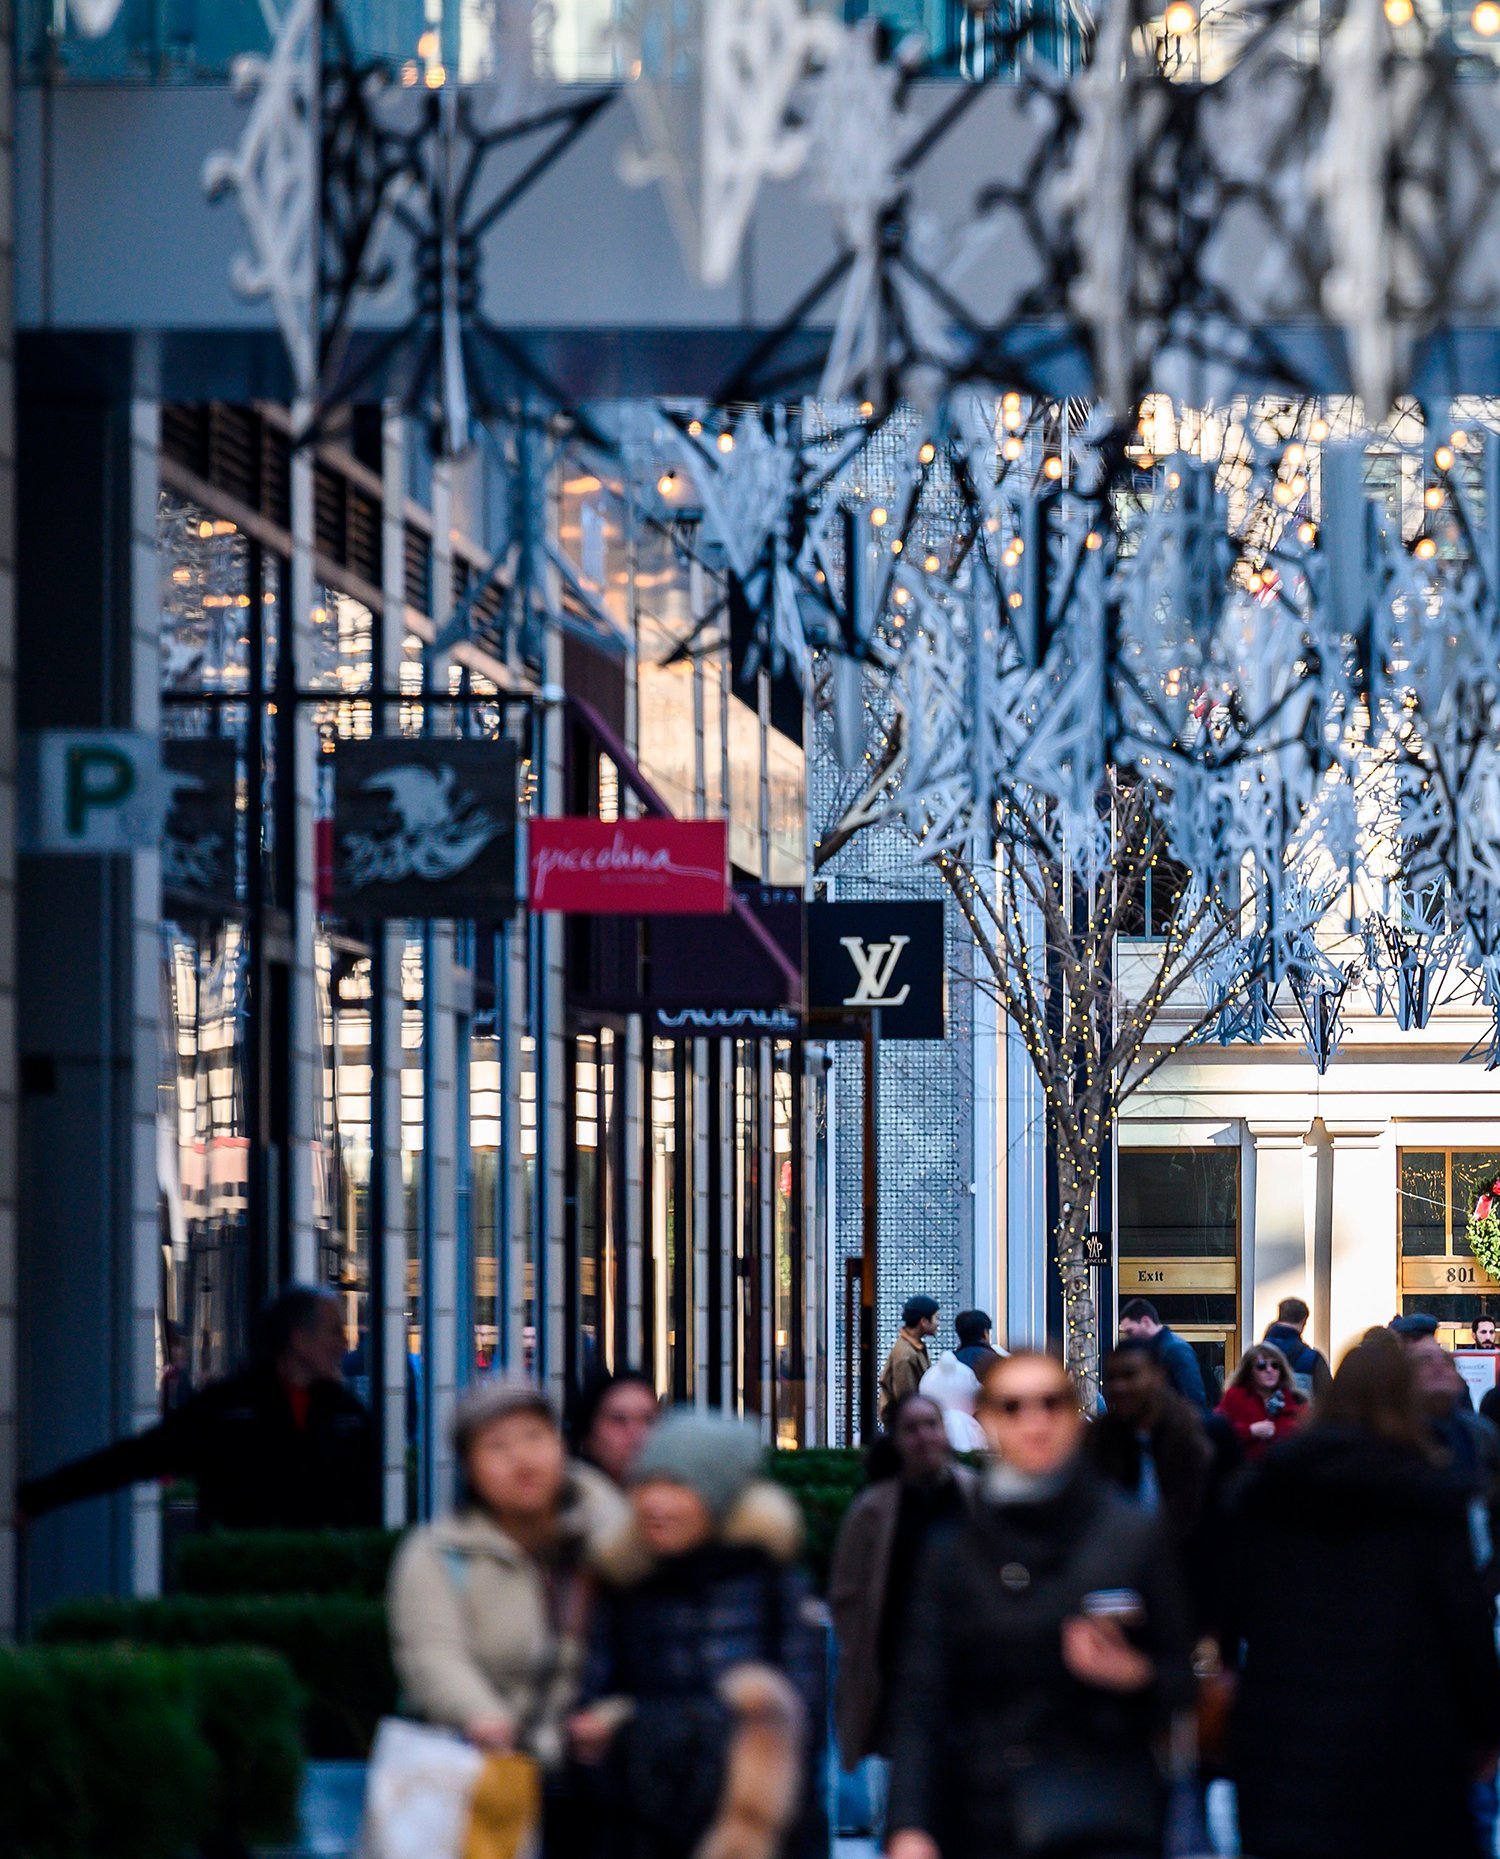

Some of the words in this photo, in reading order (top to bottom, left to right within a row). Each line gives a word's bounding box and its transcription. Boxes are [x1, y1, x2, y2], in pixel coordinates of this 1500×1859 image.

[66, 747, 135, 838] P
[532, 829, 721, 901] piccolina
[1138, 1270, 1164, 1282] Exit
[1447, 1267, 1475, 1283] 801
